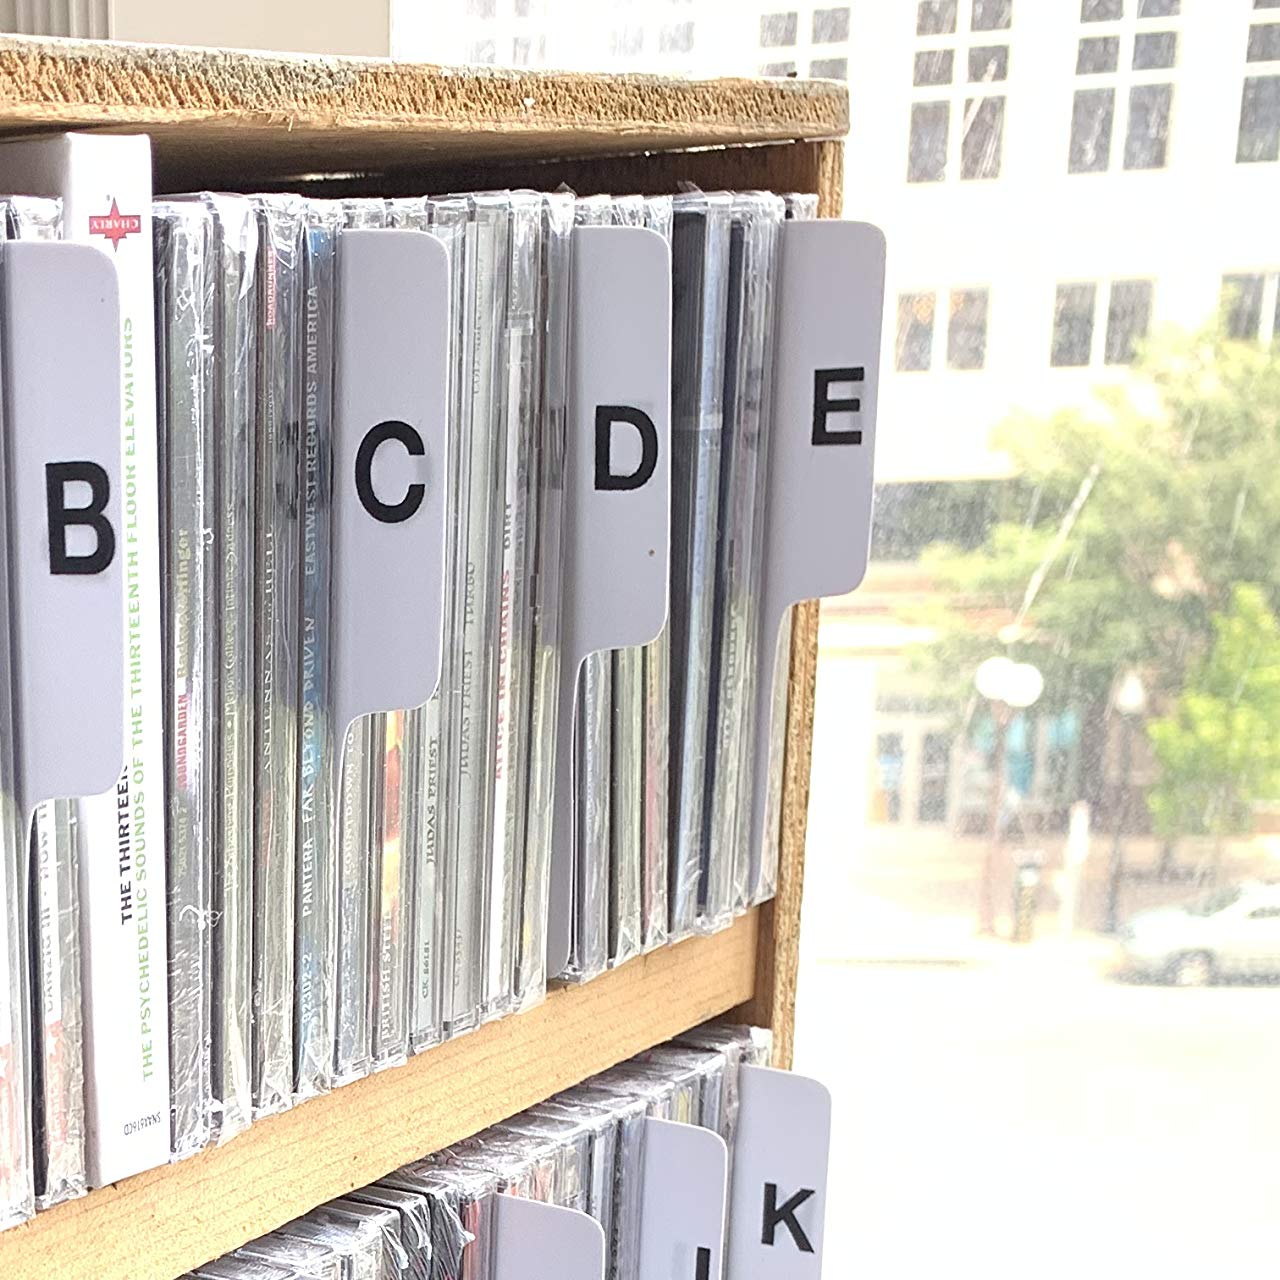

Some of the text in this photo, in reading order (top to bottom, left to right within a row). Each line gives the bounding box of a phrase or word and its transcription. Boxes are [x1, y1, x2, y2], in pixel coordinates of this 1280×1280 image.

[91, 219, 139, 229] CHARLY
[266, 248, 275, 326] ROADRUNNER
[812, 366, 865, 446] E
[355, 420, 425, 524] C
[595, 404, 658, 491] D
[45, 461, 116, 576] B
[224, 501, 236, 563] Sadness
[463, 561, 476, 628] TURBO
[499, 570, 511, 664] CHAINS
[299, 285, 319, 1024] 92302-2 PANTERA FAR BEYOND DRIVEN EASTWEST RECORDS AMERICA
[461, 649, 473, 711] PRIEST
[498, 675, 508, 700] IN
[123, 317, 154, 1082] THE PSYCHEDELIC SOUNDS OF THE THIRTEENTH FLOOR ELEVATORS
[223, 669, 236, 716] Mellon
[262, 632, 273, 775] ANTENNAS
[176, 693, 189, 790] SOUNDGARDEN
[346, 731, 355, 754] TO
[427, 735, 439, 798] PRIEST
[459, 716, 471, 778] JUDAS
[495, 716, 508, 781] ALICE
[344, 759, 356, 875] COUNTDOWN
[425, 803, 437, 864] JUDAS
[118, 882, 132, 926] THE
[380, 912, 393, 1040] BRITISH STEEL
[421, 979, 431, 1000] CK
[761, 1184, 815, 1254] K
